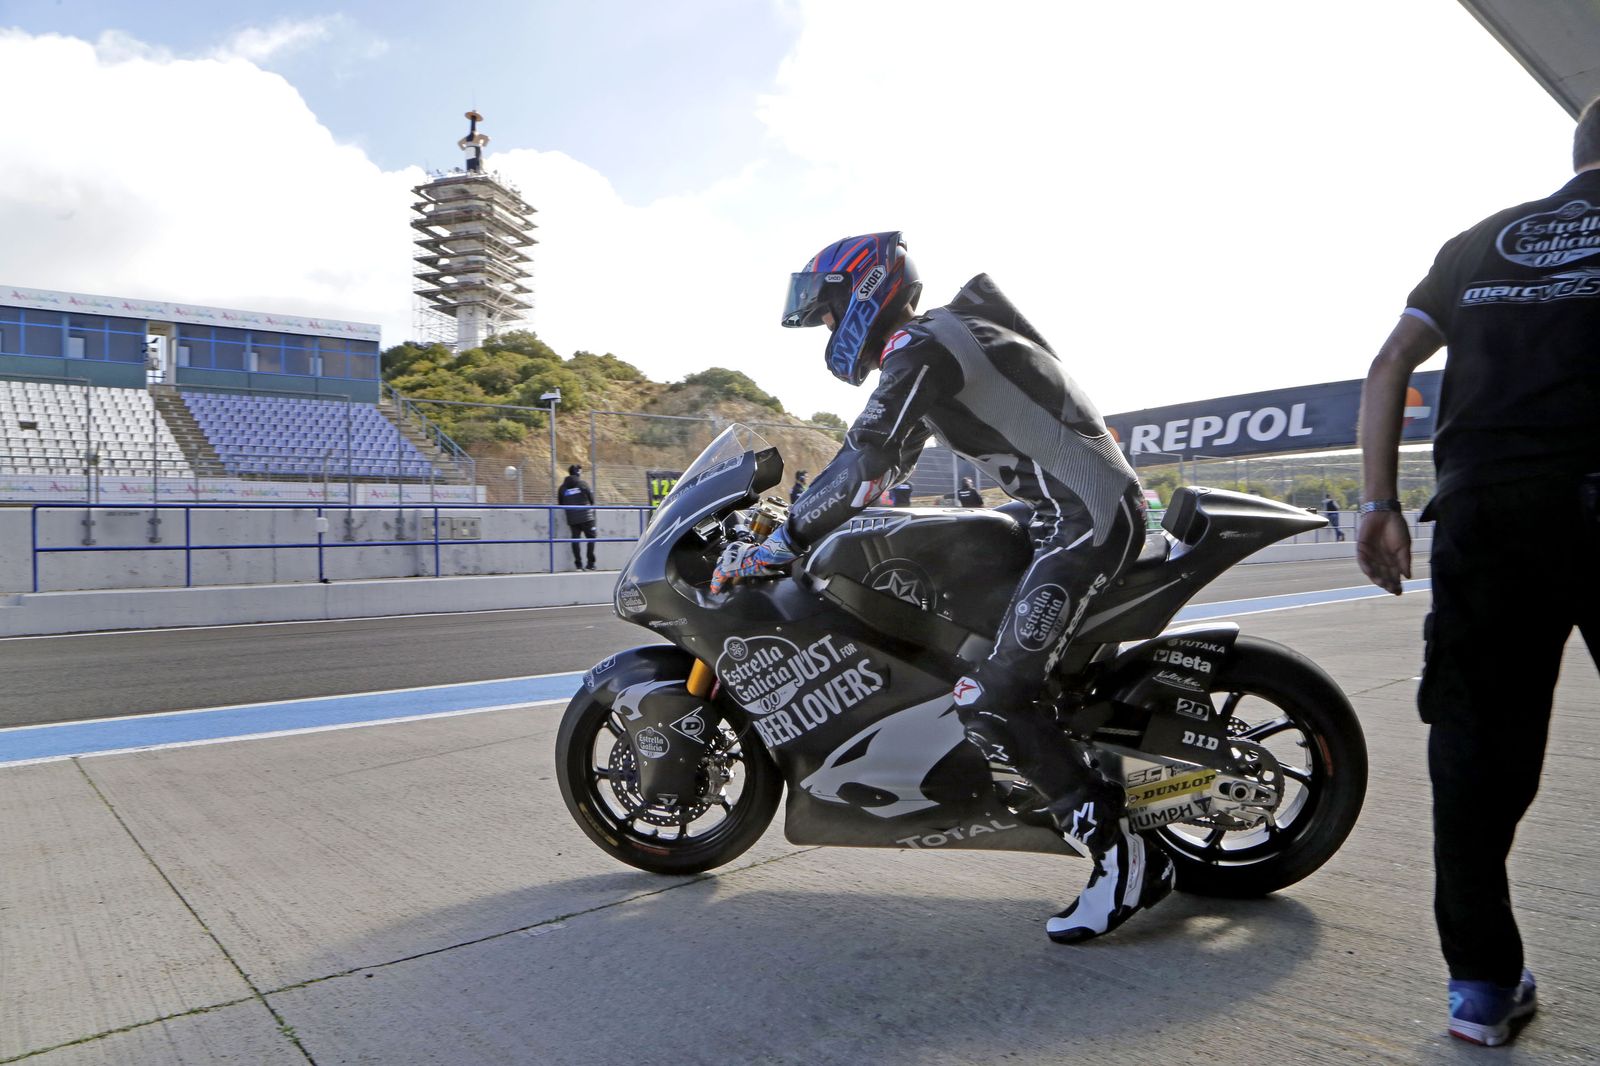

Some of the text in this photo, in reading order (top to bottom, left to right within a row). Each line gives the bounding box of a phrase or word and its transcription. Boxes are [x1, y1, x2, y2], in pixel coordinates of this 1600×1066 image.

[1515, 216, 1600, 236] Estrell
[860, 269, 884, 297] SHOEI
[1129, 402, 1313, 455] REPSOL
[801, 492, 847, 524] TOTAL
[1020, 590, 1052, 639] Estrella
[1033, 599, 1063, 642] Galicia
[787, 634, 858, 688] JUST FOR
[1168, 651, 1212, 674] Beta
[1179, 640, 1225, 654] YUTAKA
[721, 645, 784, 687] Estrella
[735, 666, 792, 702] Galicia
[753, 658, 884, 748] BEER LOVERS
[1178, 700, 1208, 720] 2D
[638, 733, 664, 745] Estrella
[1143, 774, 1216, 801] DUNLOP
[896, 820, 1018, 851] TOTAL
